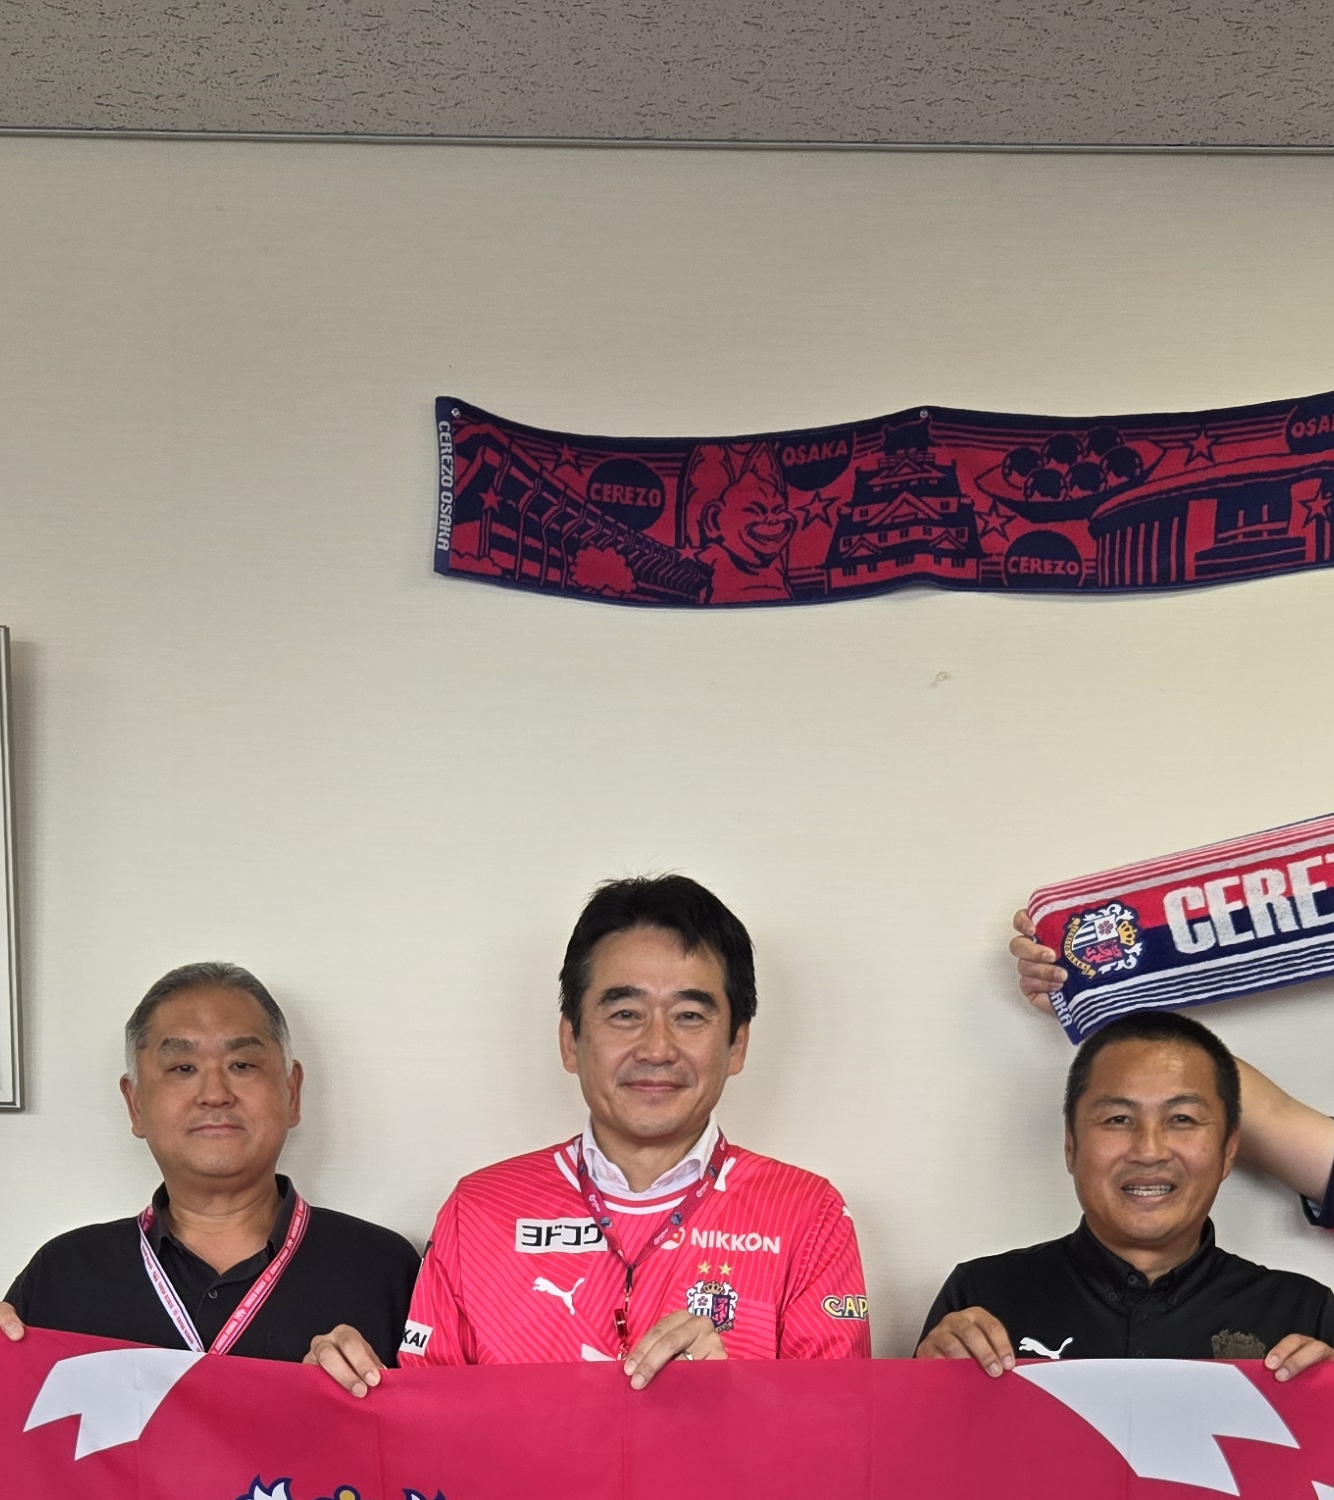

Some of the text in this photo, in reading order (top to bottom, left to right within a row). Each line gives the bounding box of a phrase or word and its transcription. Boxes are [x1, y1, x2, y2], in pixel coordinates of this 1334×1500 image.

[780, 439, 849, 467] OSAKA
[436, 420, 454, 552] CEREZO OSAKA
[589, 482, 663, 509] CEREZO
[1007, 556, 1081, 578] CEREZO
[690, 1227, 781, 1255] NIKKON
